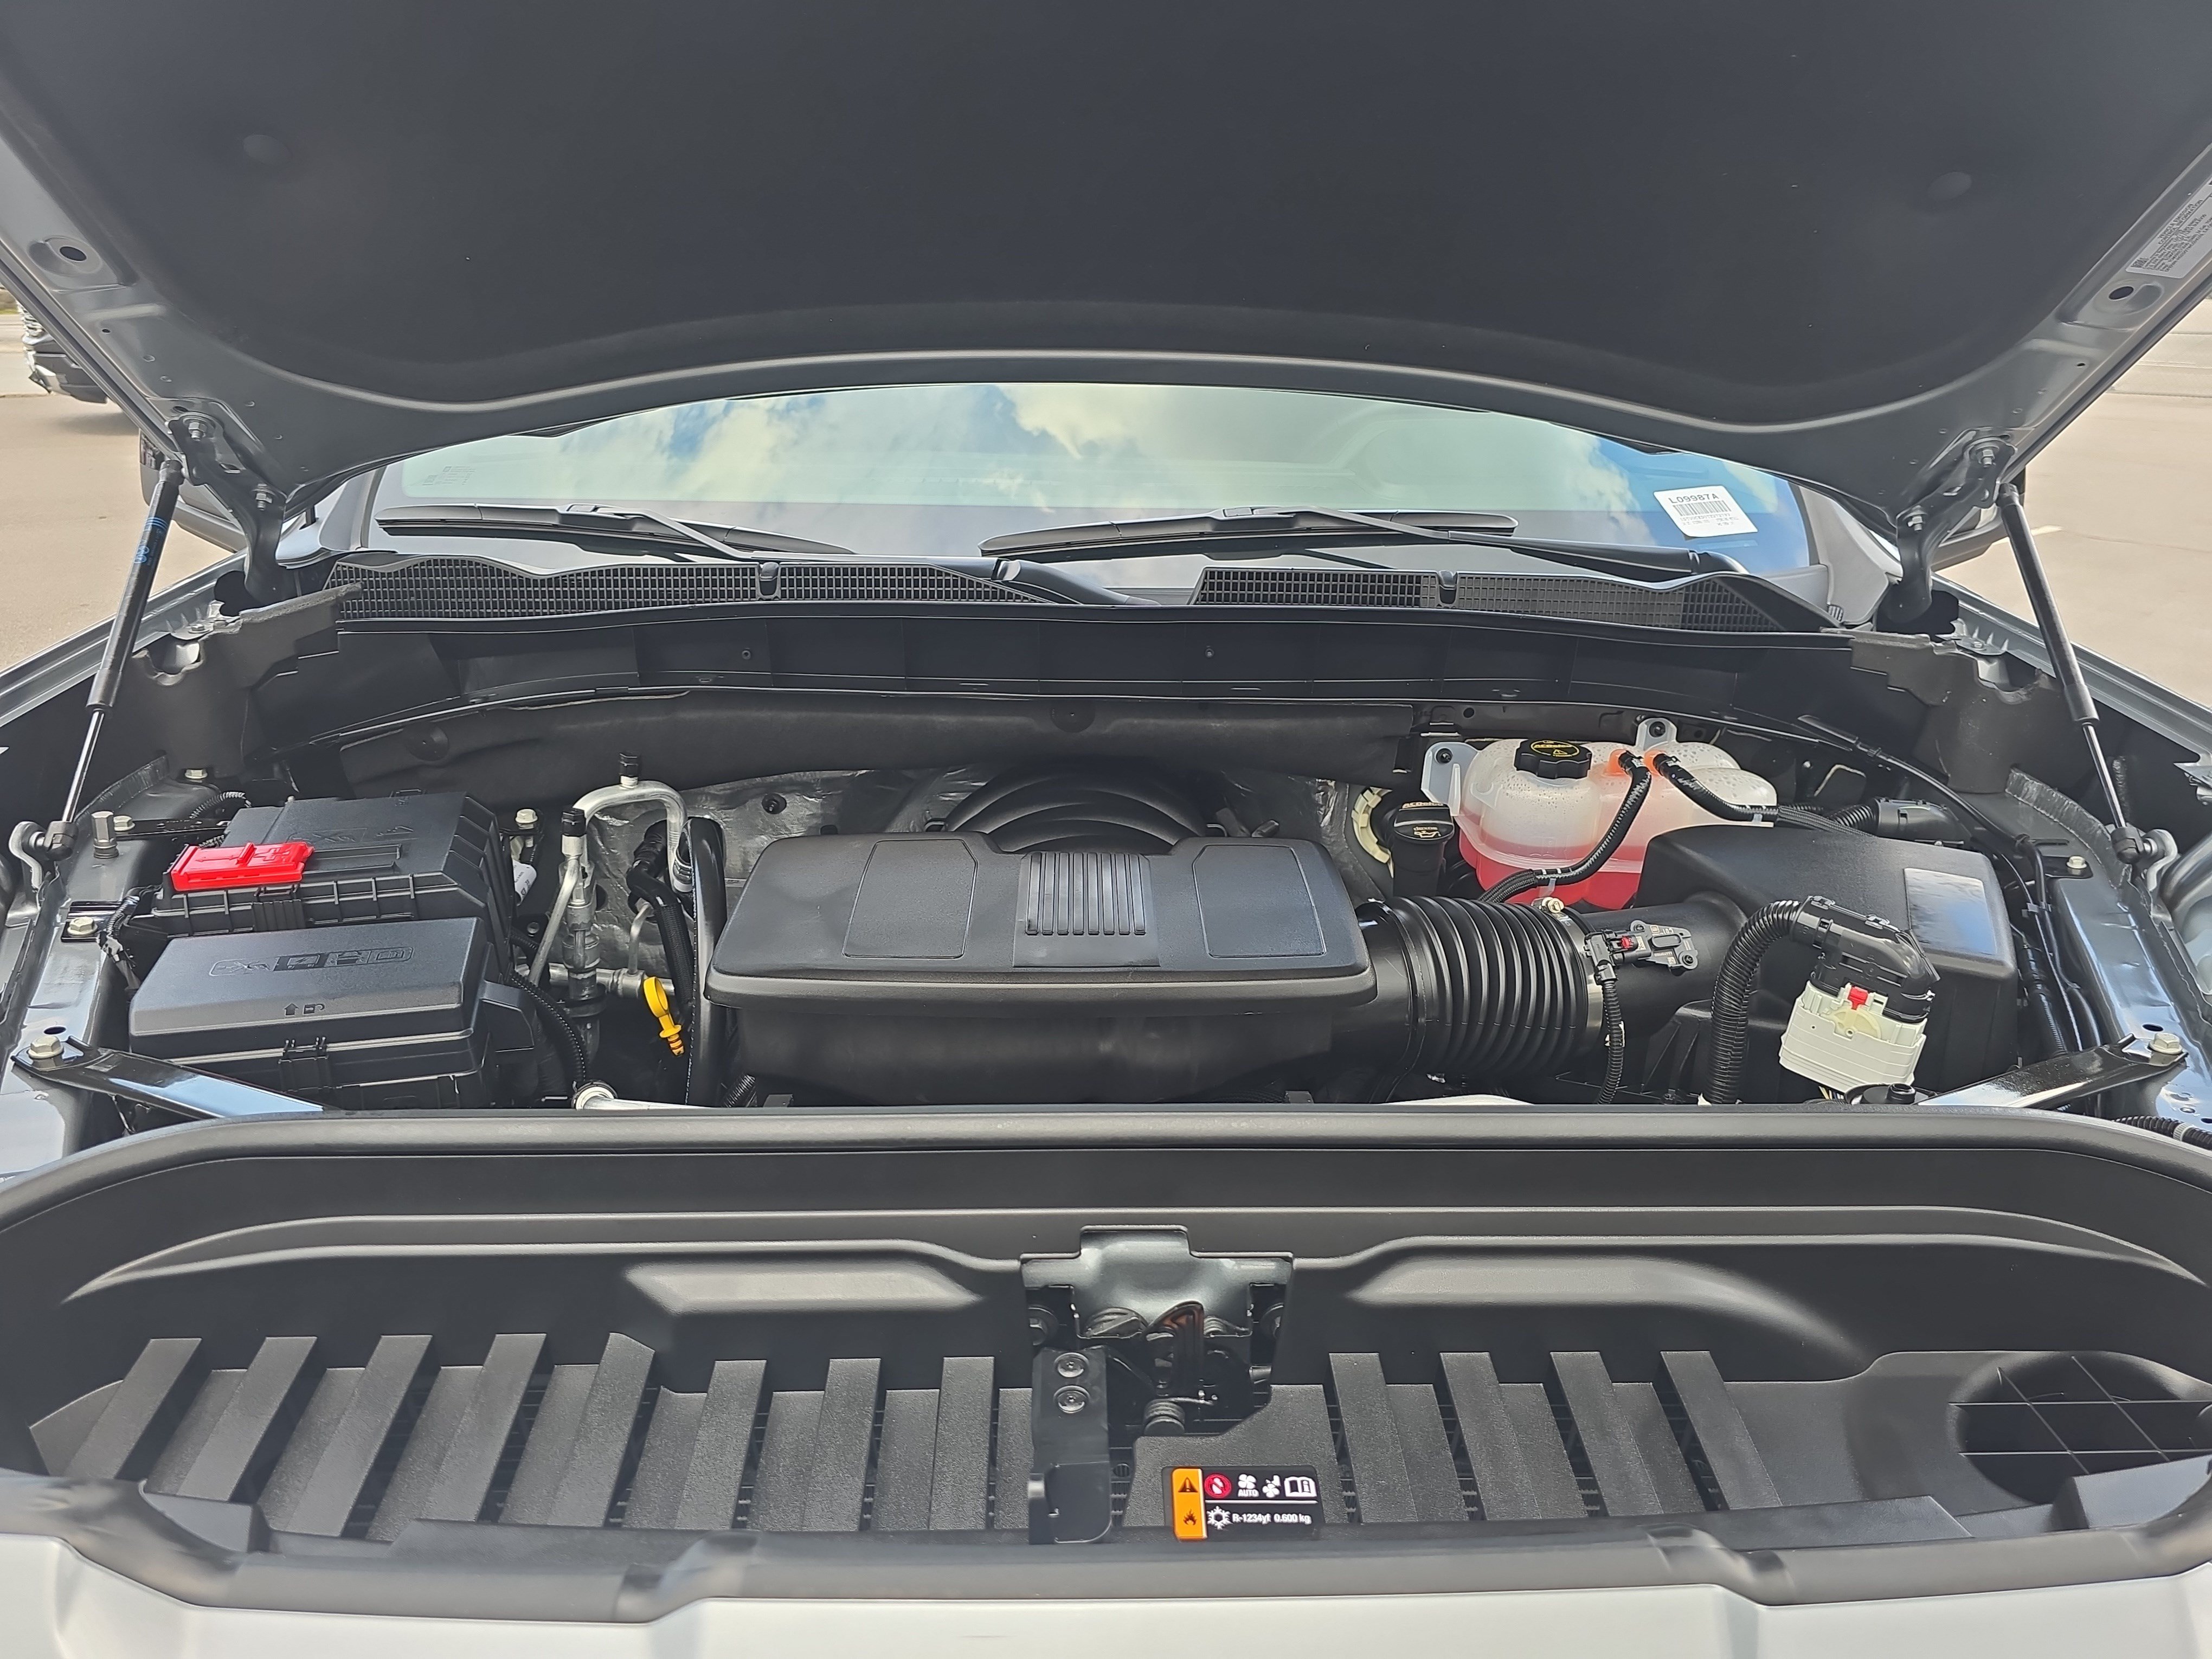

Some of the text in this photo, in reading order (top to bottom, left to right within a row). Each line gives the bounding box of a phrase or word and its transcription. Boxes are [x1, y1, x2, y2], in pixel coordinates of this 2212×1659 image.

[1668, 493, 1719, 504] L09987A
[1237, 1489, 1259, 1497] AUTO
[1232, 1513, 1311, 1525] R-1234yf 0.600 kg
